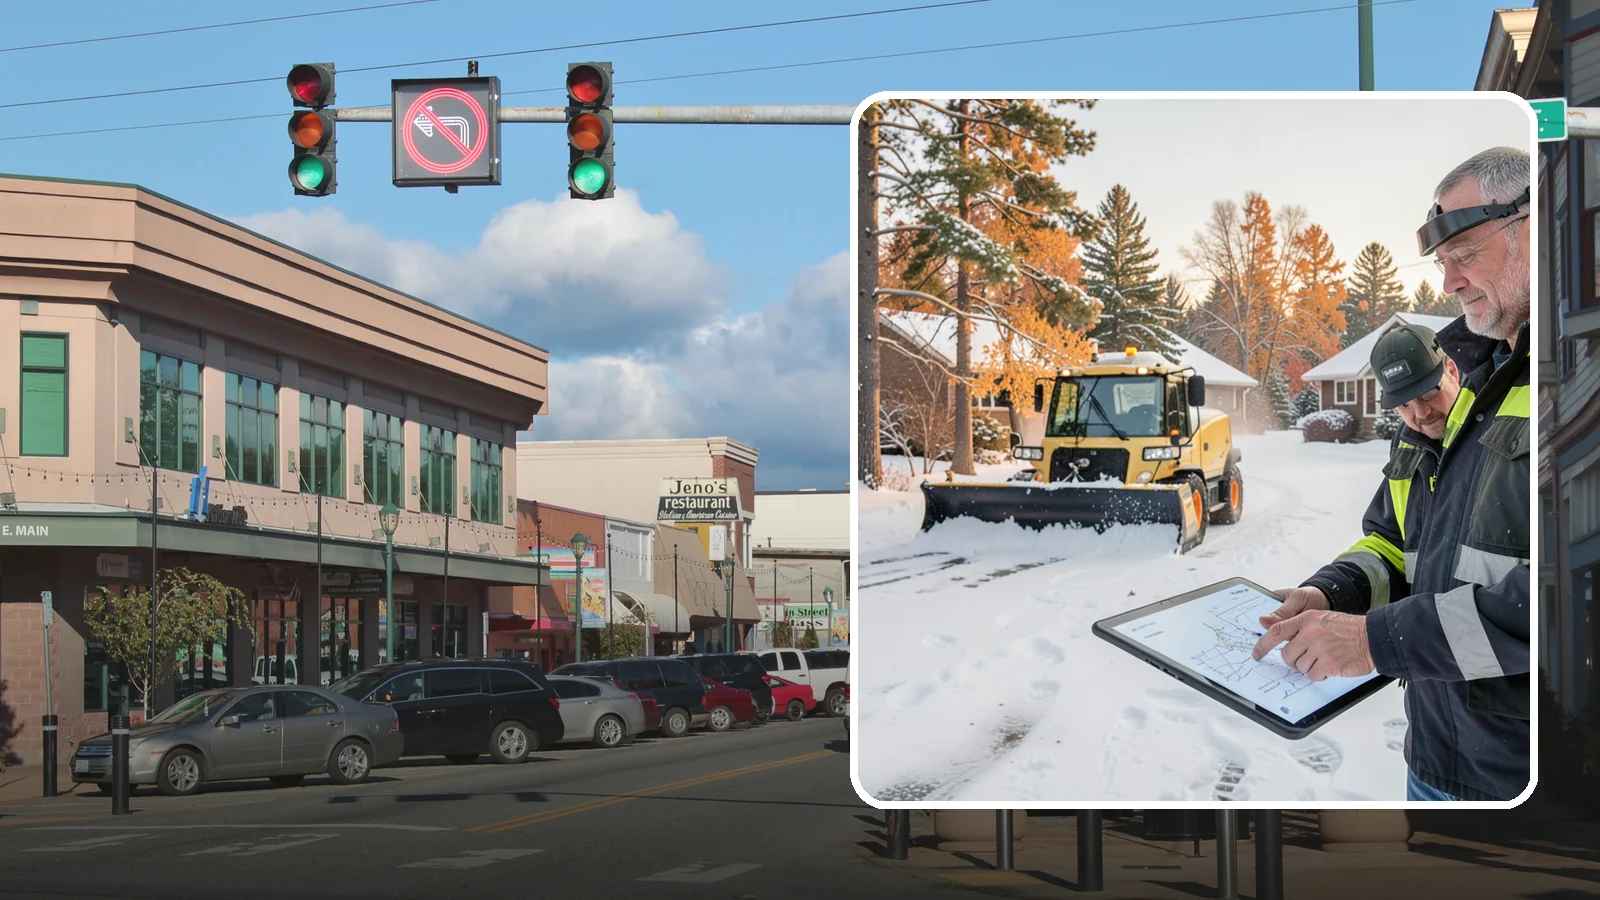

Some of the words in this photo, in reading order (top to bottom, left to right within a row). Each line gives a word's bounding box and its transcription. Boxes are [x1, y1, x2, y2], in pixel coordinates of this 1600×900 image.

[669, 480, 728, 494] Jeno's
[665, 496, 731, 509] restaurant
[658, 509, 681, 519] Italian
[685, 509, 715, 519] American
[715, 509, 738, 519] Cuisine
[2, 525, 13, 536] E.
[15, 525, 49, 536] MAIN
[797, 608, 829, 617] Street
